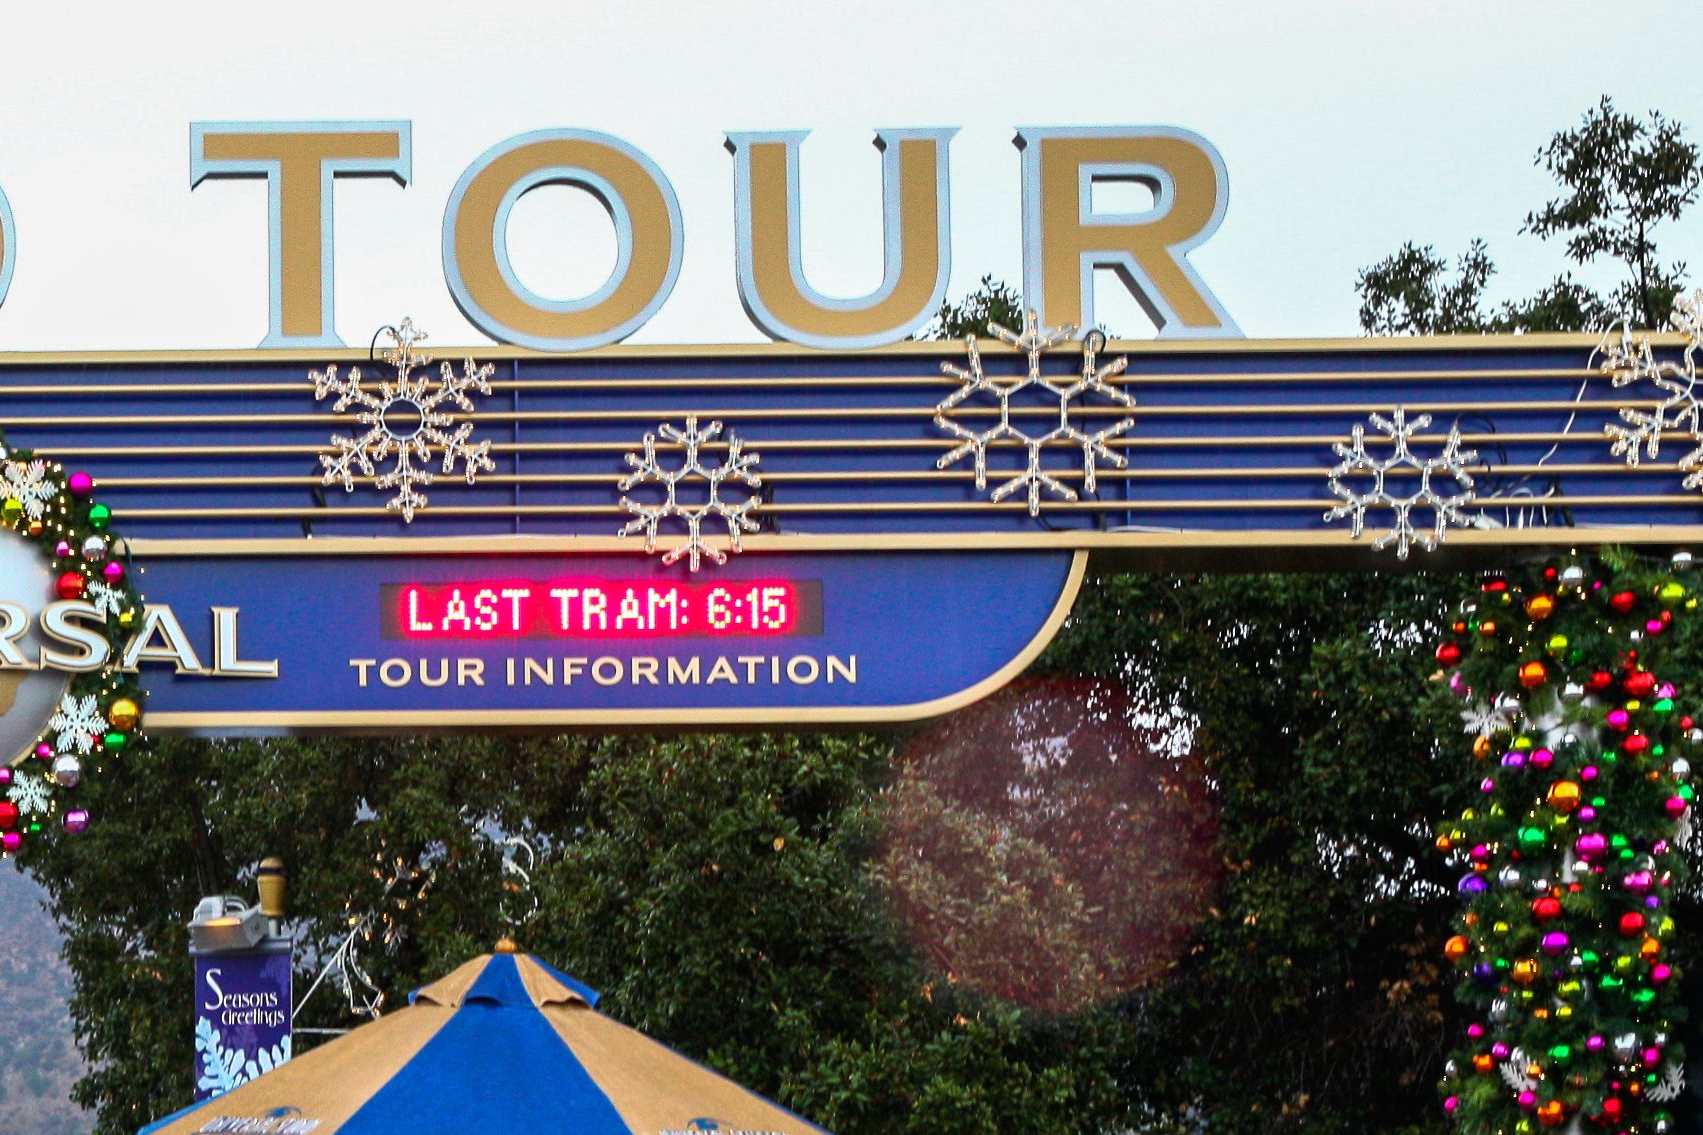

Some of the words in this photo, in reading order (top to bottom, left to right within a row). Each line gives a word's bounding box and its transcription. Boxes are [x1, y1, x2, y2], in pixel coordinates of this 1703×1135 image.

[189, 119, 1248, 352] TOUR
[408, 586, 531, 632] LAST
[551, 586, 689, 631] TRAM:
[707, 586, 787, 630] 6:15
[349, 657, 485, 688] TOUR
[506, 654, 859, 687] INFORMATION
[205, 967, 278, 1010] Seasons
[221, 1008, 285, 1028] Greetings
